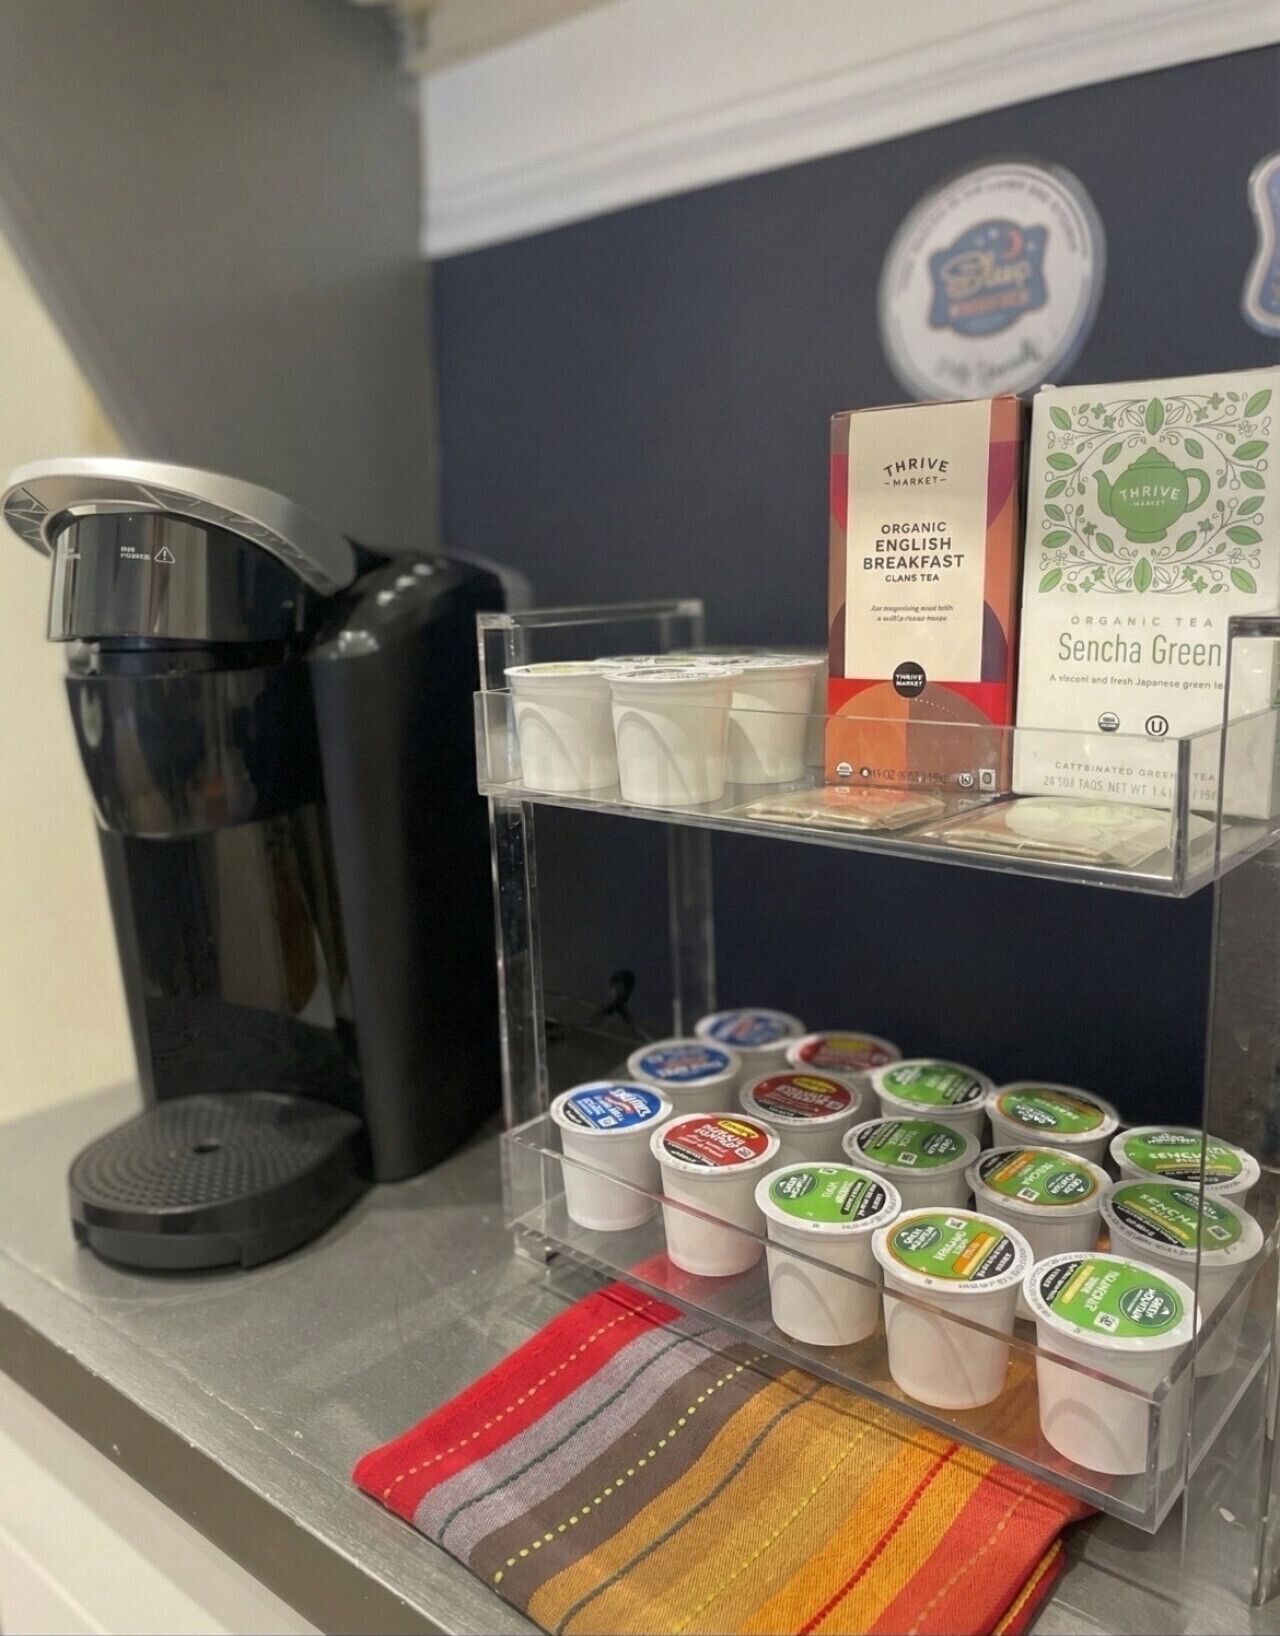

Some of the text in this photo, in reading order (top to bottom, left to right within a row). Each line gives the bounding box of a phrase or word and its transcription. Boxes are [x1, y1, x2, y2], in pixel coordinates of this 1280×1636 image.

[883, 457, 949, 477] THRIVE
[893, 476, 938, 487] MARKET
[1119, 485, 1180, 501] THRIVE
[881, 521, 947, 535] ORGANIC
[875, 537, 952, 552] ENGLISH
[863, 554, 965, 571] BREAKFAST
[920, 573, 940, 583] TEA
[1070, 615, 1213, 628] ORGANIC TEA
[1058, 632, 1222, 667] Sencha Green
[1136, 678, 1180, 688] Japanese
[1183, 681, 1211, 690] green
[1192, 772, 1216, 782] TEA
